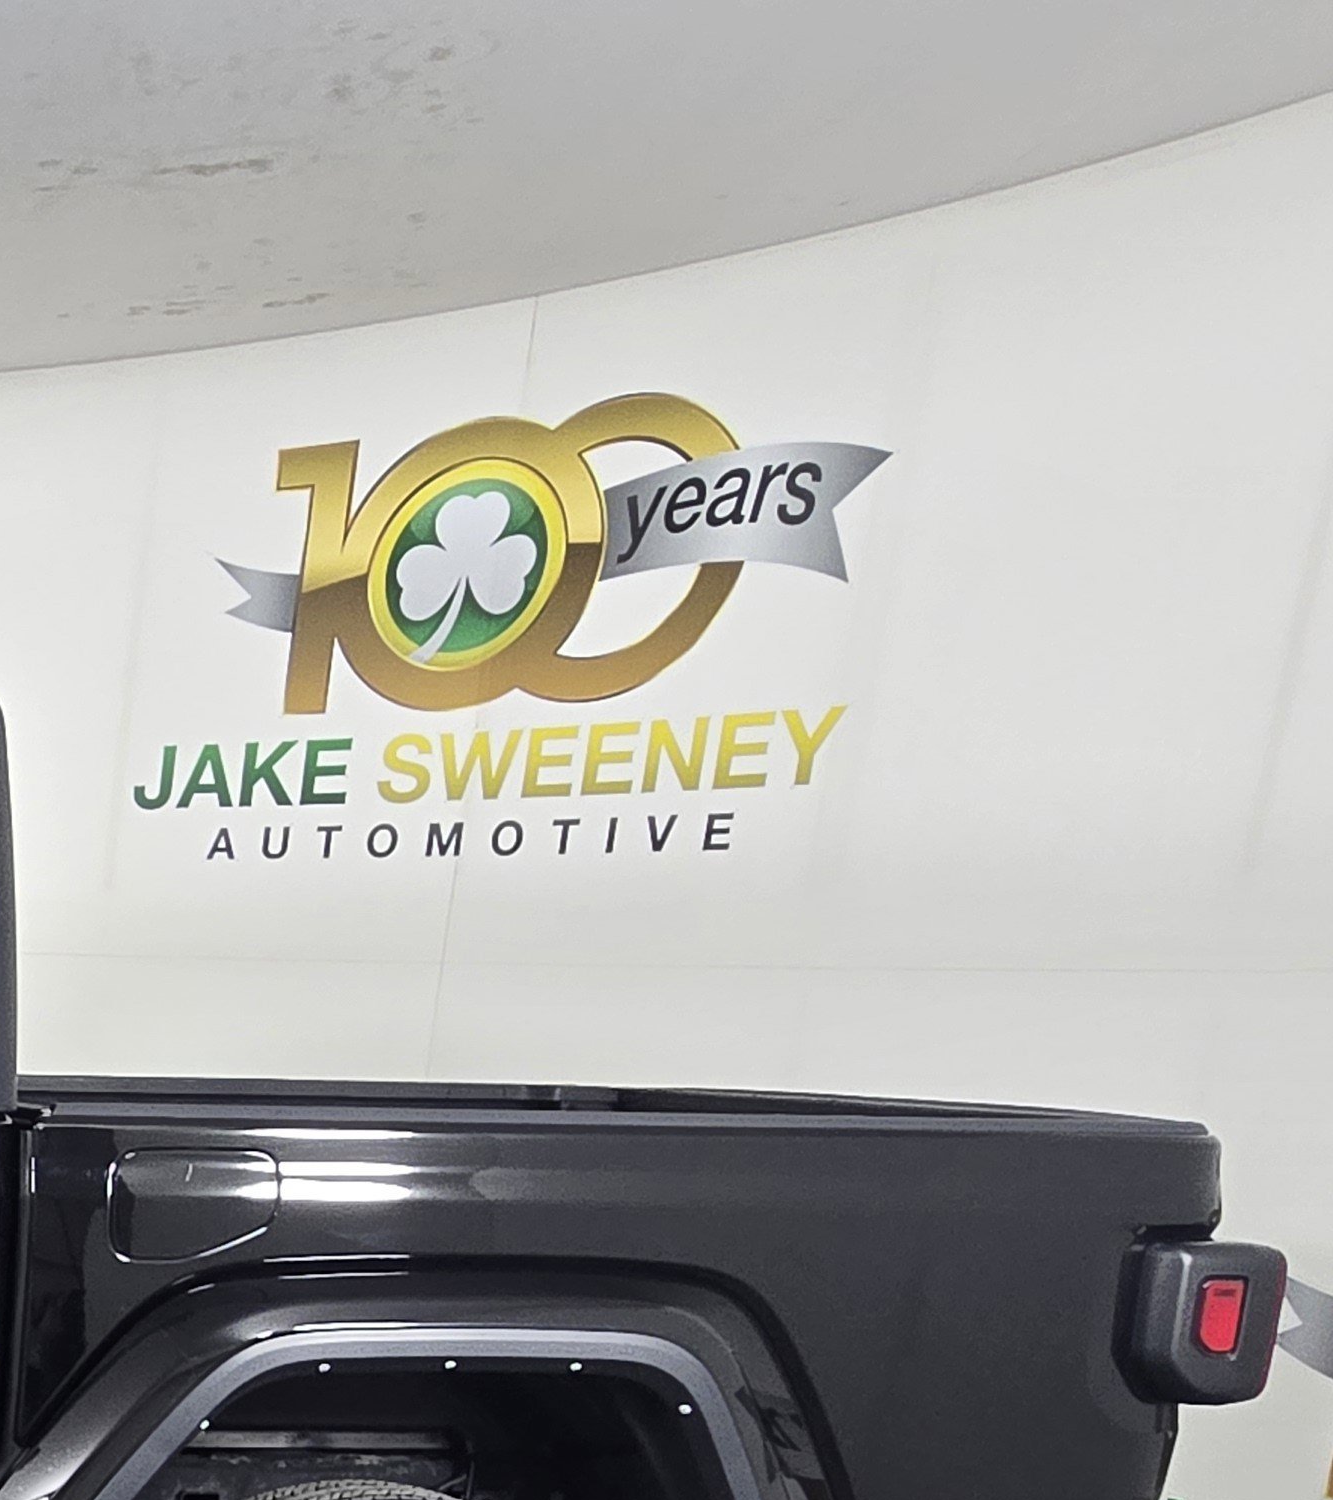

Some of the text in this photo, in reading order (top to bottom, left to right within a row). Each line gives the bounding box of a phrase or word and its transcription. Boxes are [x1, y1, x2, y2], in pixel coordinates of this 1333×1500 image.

[275, 391, 744, 715] 100
[616, 453, 823, 565] years
[132, 704, 849, 812] JAKE SWEENEY
[207, 812, 738, 862] AUTOMOTIVE
